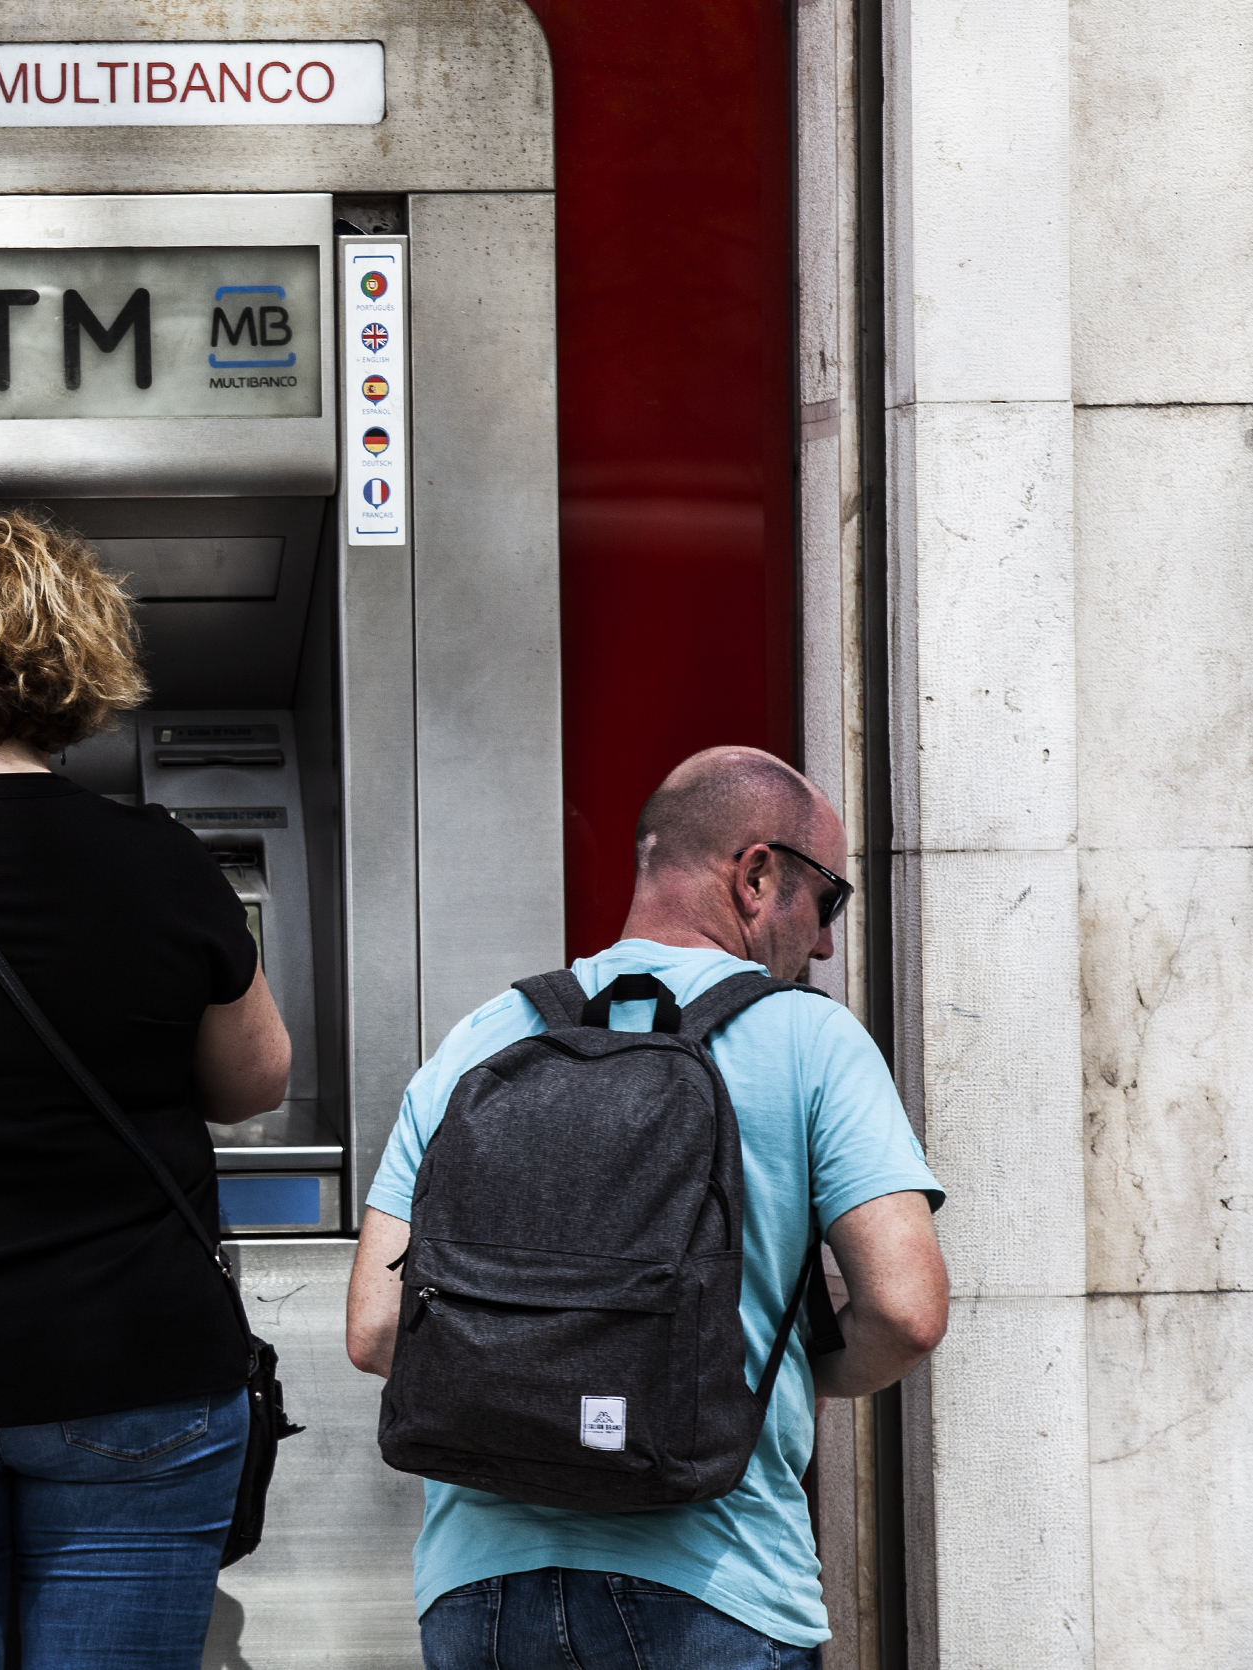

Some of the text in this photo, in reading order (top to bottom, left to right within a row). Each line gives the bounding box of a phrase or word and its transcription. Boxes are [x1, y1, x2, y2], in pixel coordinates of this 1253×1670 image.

[356, 303, 395, 311] PORTUGUÊS
[211, 306, 293, 347] MB
[209, 376, 297, 389] MULTIBANCO
[362, 407, 391, 415] ESPAÑOL
